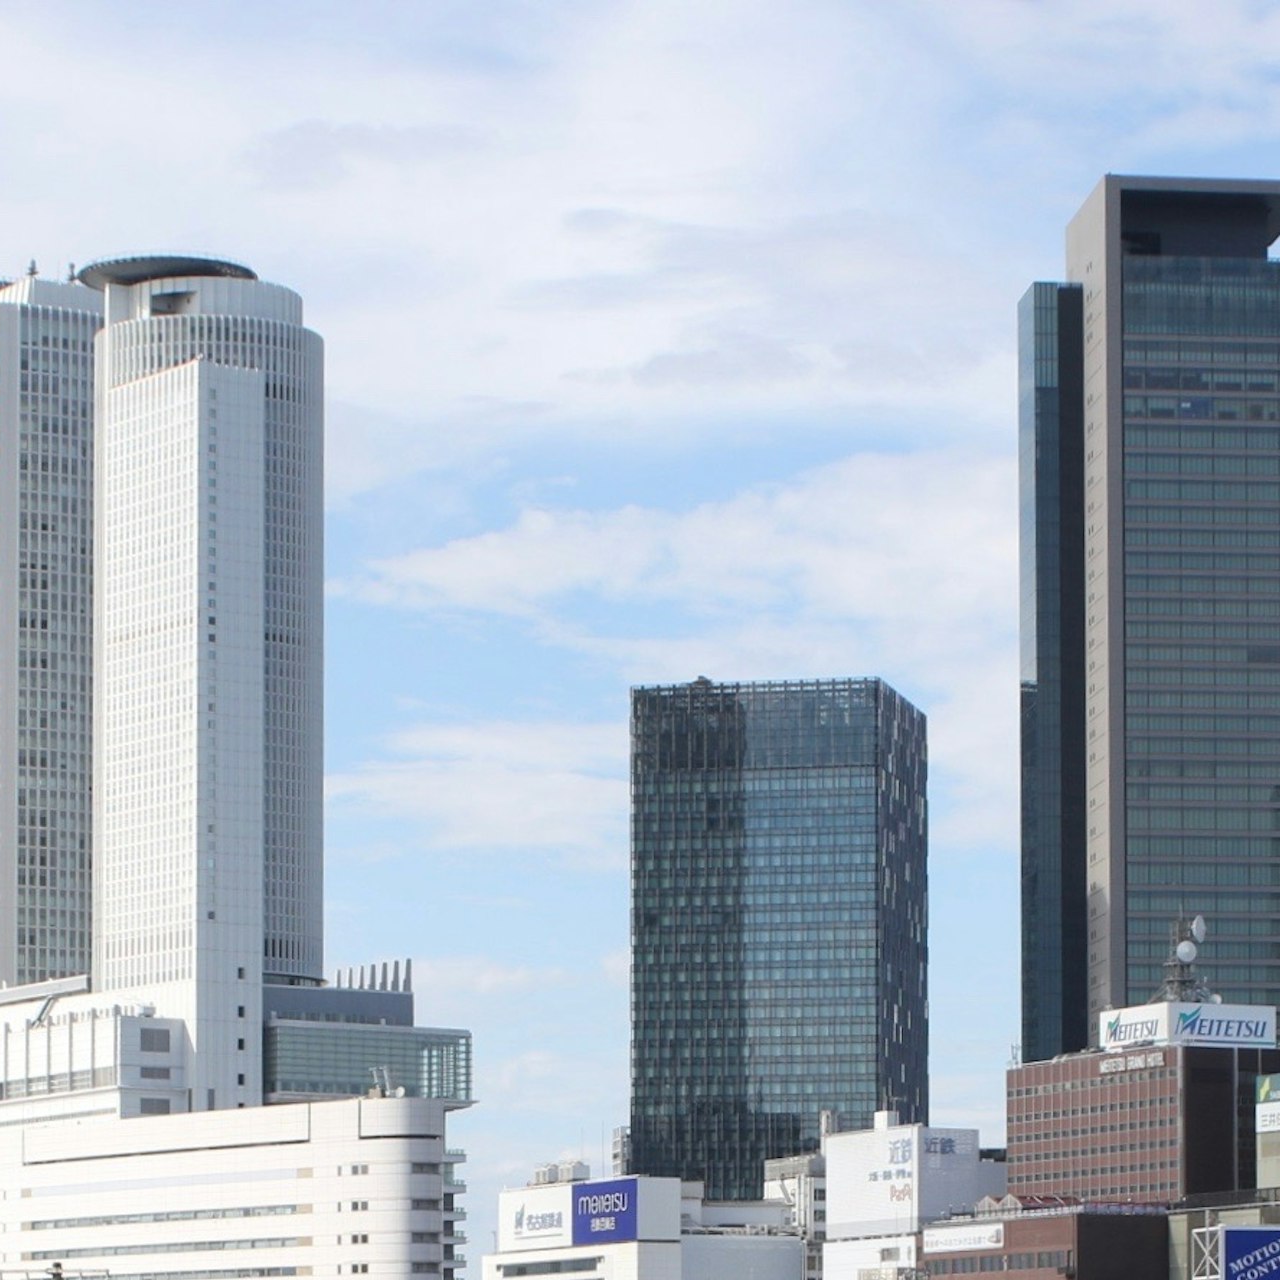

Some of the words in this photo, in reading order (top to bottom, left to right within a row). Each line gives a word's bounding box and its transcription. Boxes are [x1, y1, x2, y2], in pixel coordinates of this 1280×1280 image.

[1105, 1013, 1159, 1043] MEITETSU
[1174, 1006, 1267, 1038] MEITETSU
[924, 1137, 955, 1154] 近鉄
